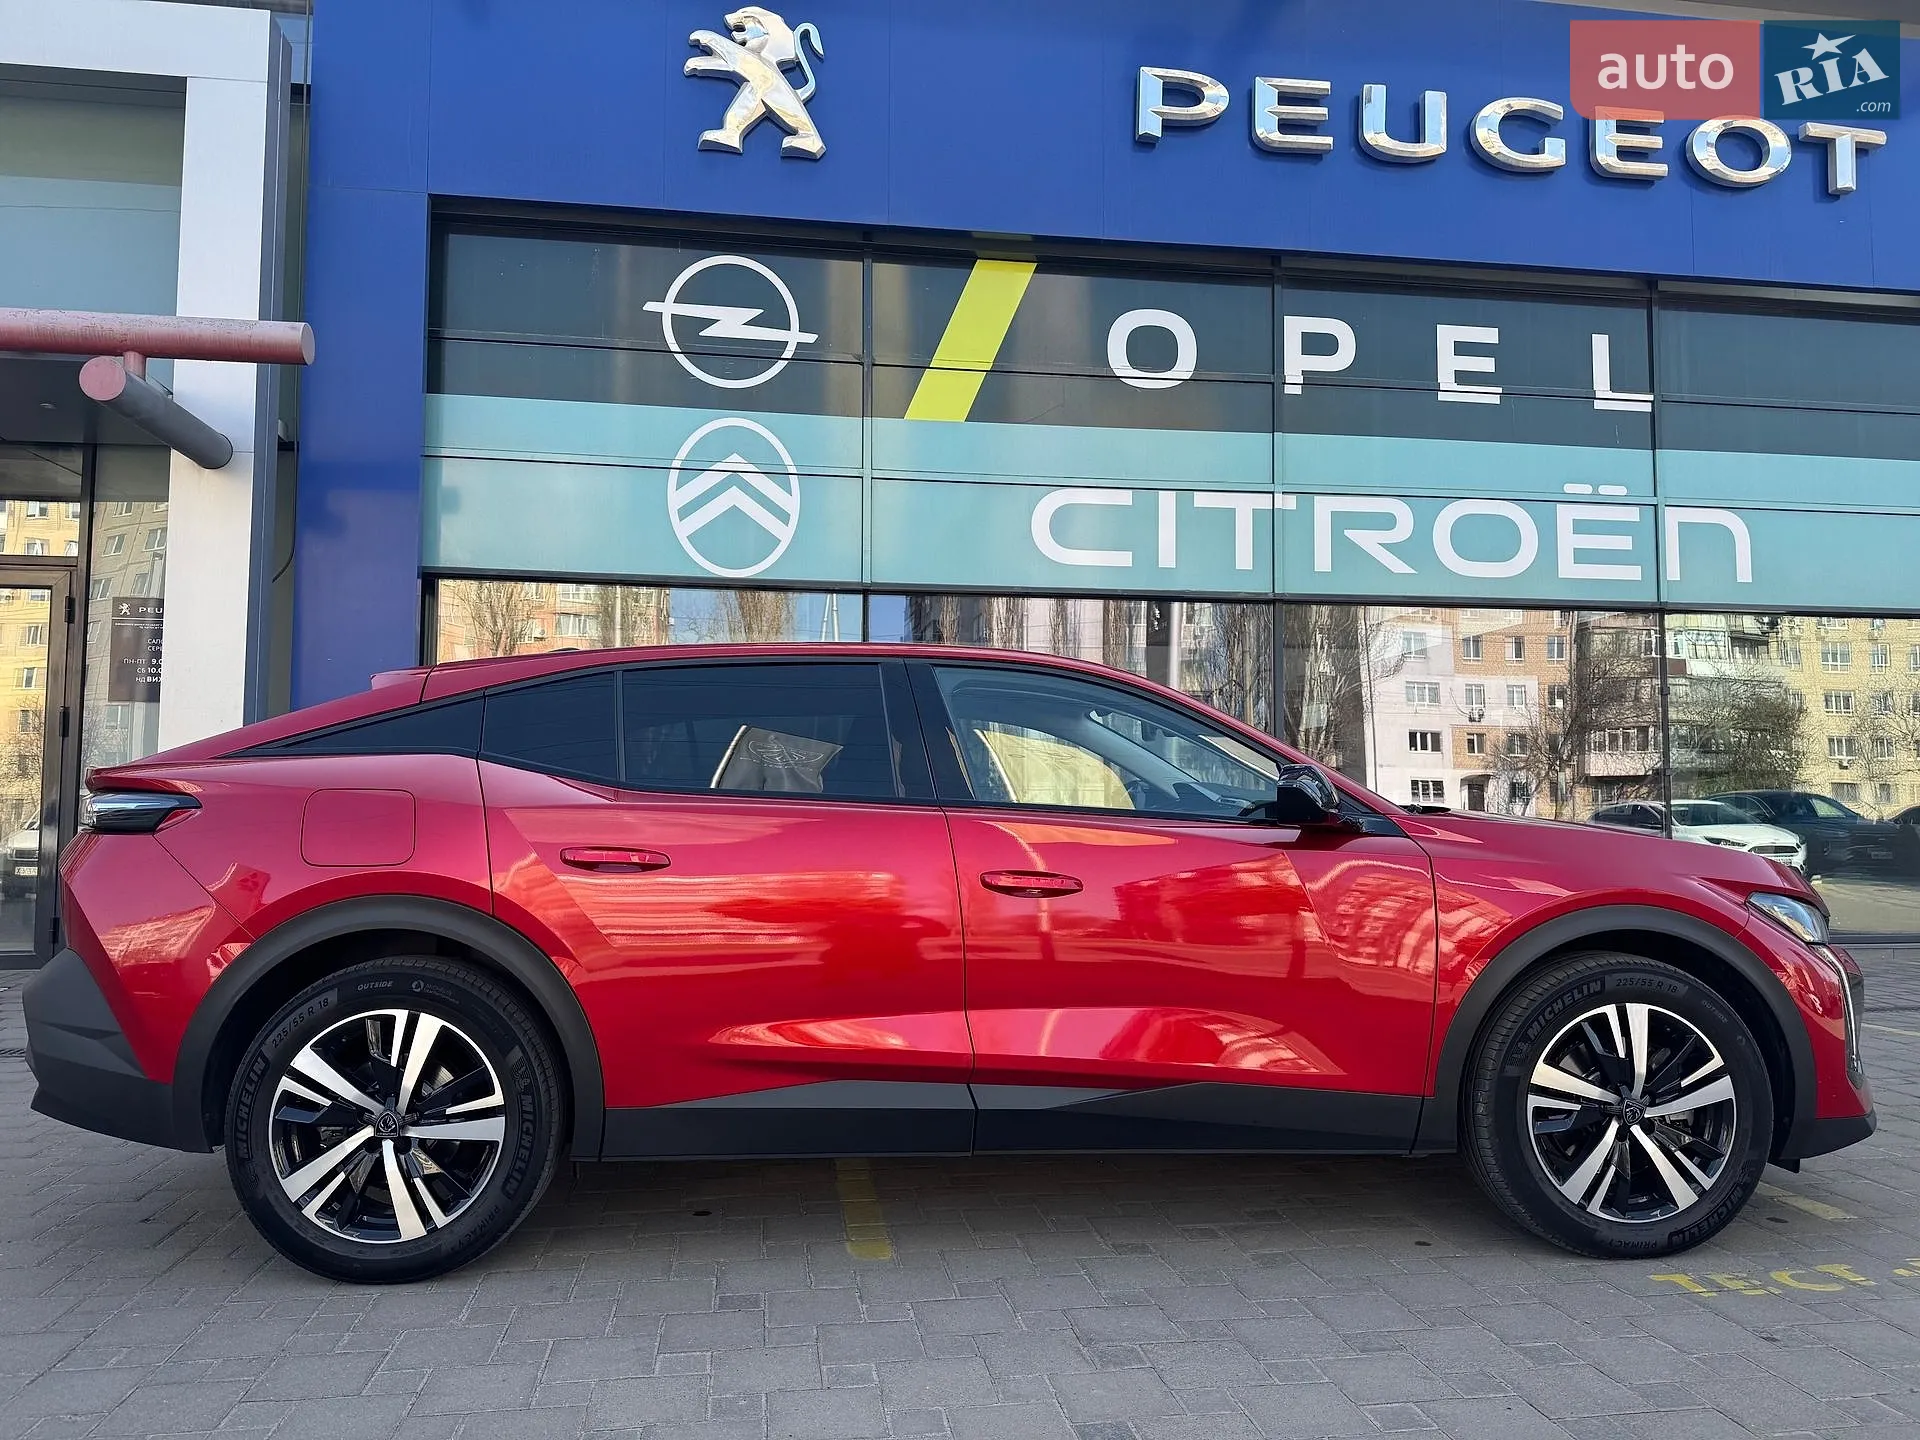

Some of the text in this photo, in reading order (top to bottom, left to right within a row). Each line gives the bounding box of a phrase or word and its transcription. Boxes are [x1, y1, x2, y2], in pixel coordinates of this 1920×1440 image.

[1135, 64, 1888, 196] PEUGEOT
[1106, 308, 1655, 412] OPEL
[1030, 483, 1753, 584] CITROËN
[272, 998, 330, 1048] 225/55 R 18
[357, 980, 395, 991] OUTSIDE
[1526, 980, 1601, 1040] MICHELIN
[1615, 977, 1679, 993] 225/55 R 18
[236, 1056, 265, 1158] MICHELIN
[506, 1095, 534, 1196] MICHELIN
